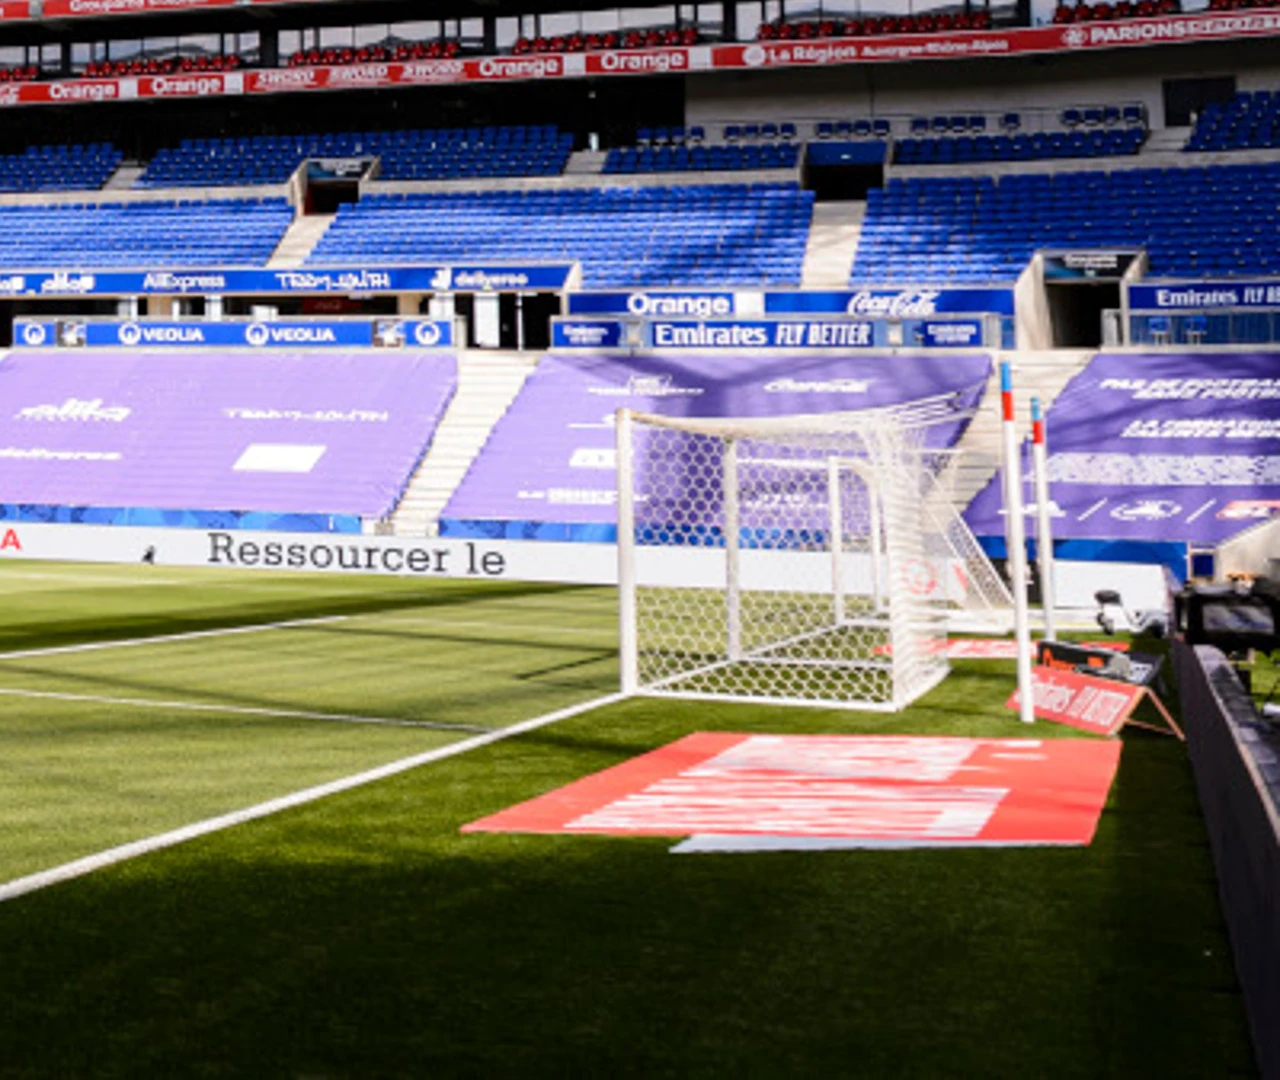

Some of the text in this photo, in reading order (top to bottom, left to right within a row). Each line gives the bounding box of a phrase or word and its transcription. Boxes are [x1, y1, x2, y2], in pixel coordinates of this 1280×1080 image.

[600, 51, 684, 72] Orange
[771, 50, 792, 63] La
[793, 46, 857, 65] Région
[479, 56, 558, 78] Orange
[48, 82, 116, 100] Orange
[151, 77, 220, 95] Orange
[627, 294, 730, 318] Orange
[1156, 286, 1239, 308] Emirates
[143, 325, 204, 342] VEOLIA
[271, 325, 336, 342] VEOLIA
[655, 322, 871, 345] Emirates FLY BETTER
[207, 533, 506, 577] Ressourcer le
